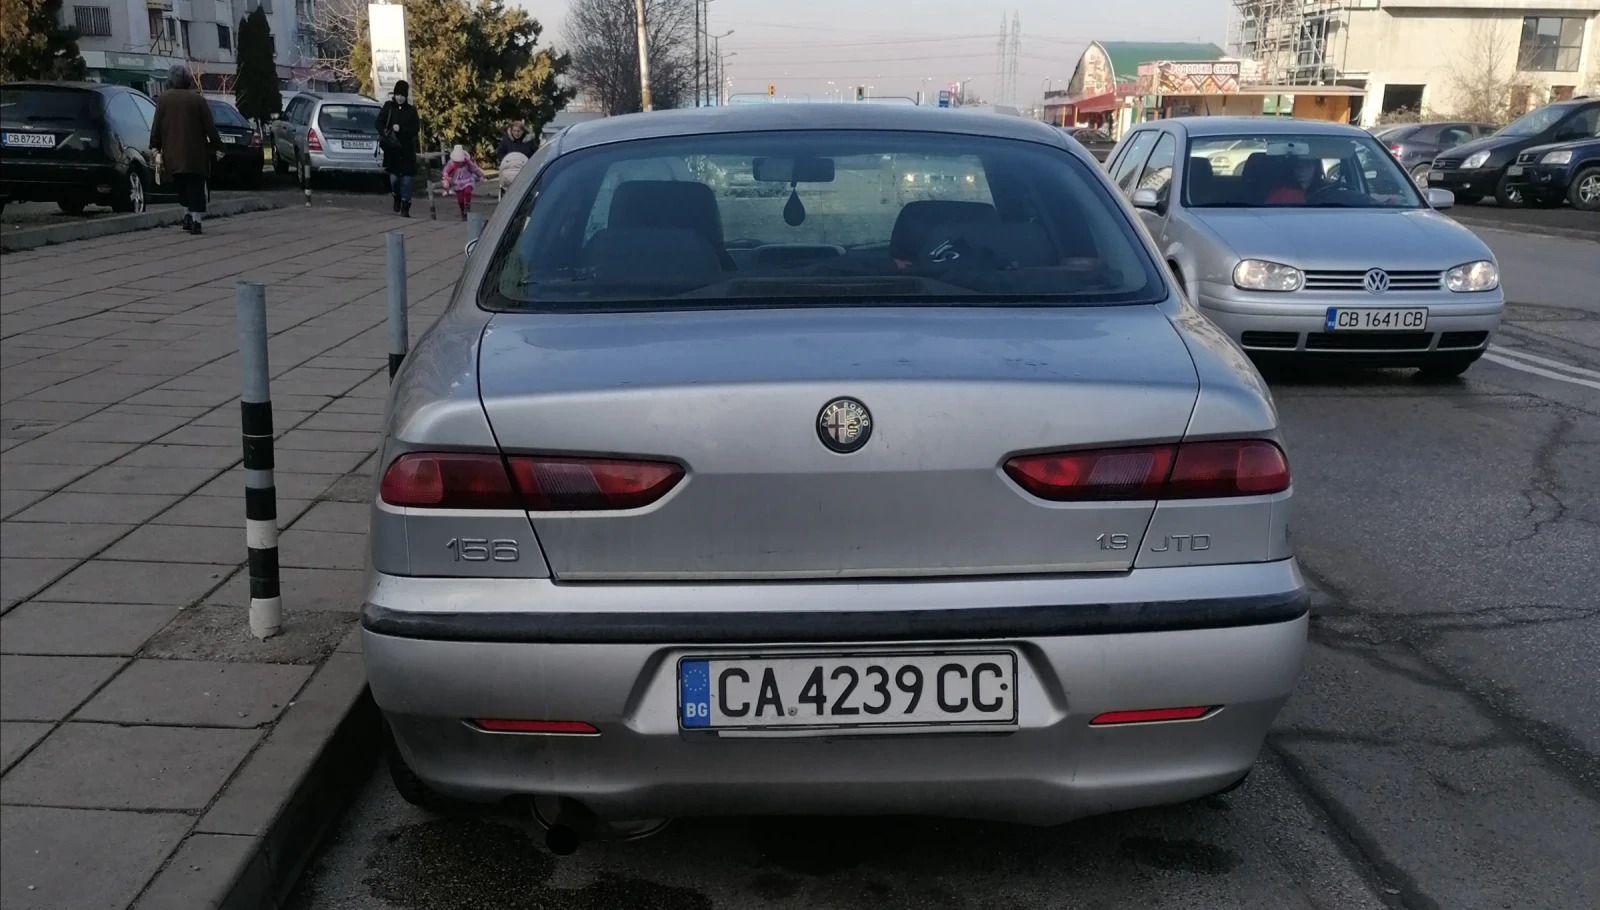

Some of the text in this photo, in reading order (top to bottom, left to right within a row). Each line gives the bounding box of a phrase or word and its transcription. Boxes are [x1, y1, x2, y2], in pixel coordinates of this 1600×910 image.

[1213, 63, 1239, 75] СКАРА
[8, 134, 54, 145] CB 8722 KA
[1338, 311, 1423, 327] CB 1641 CB
[822, 402, 869, 427] ALFA ROMEO
[446, 538, 519, 562] 156
[1096, 533, 1211, 552] 1.9 JTD
[718, 663, 1004, 717] CA 4239 CC
[686, 702, 708, 718] BG
